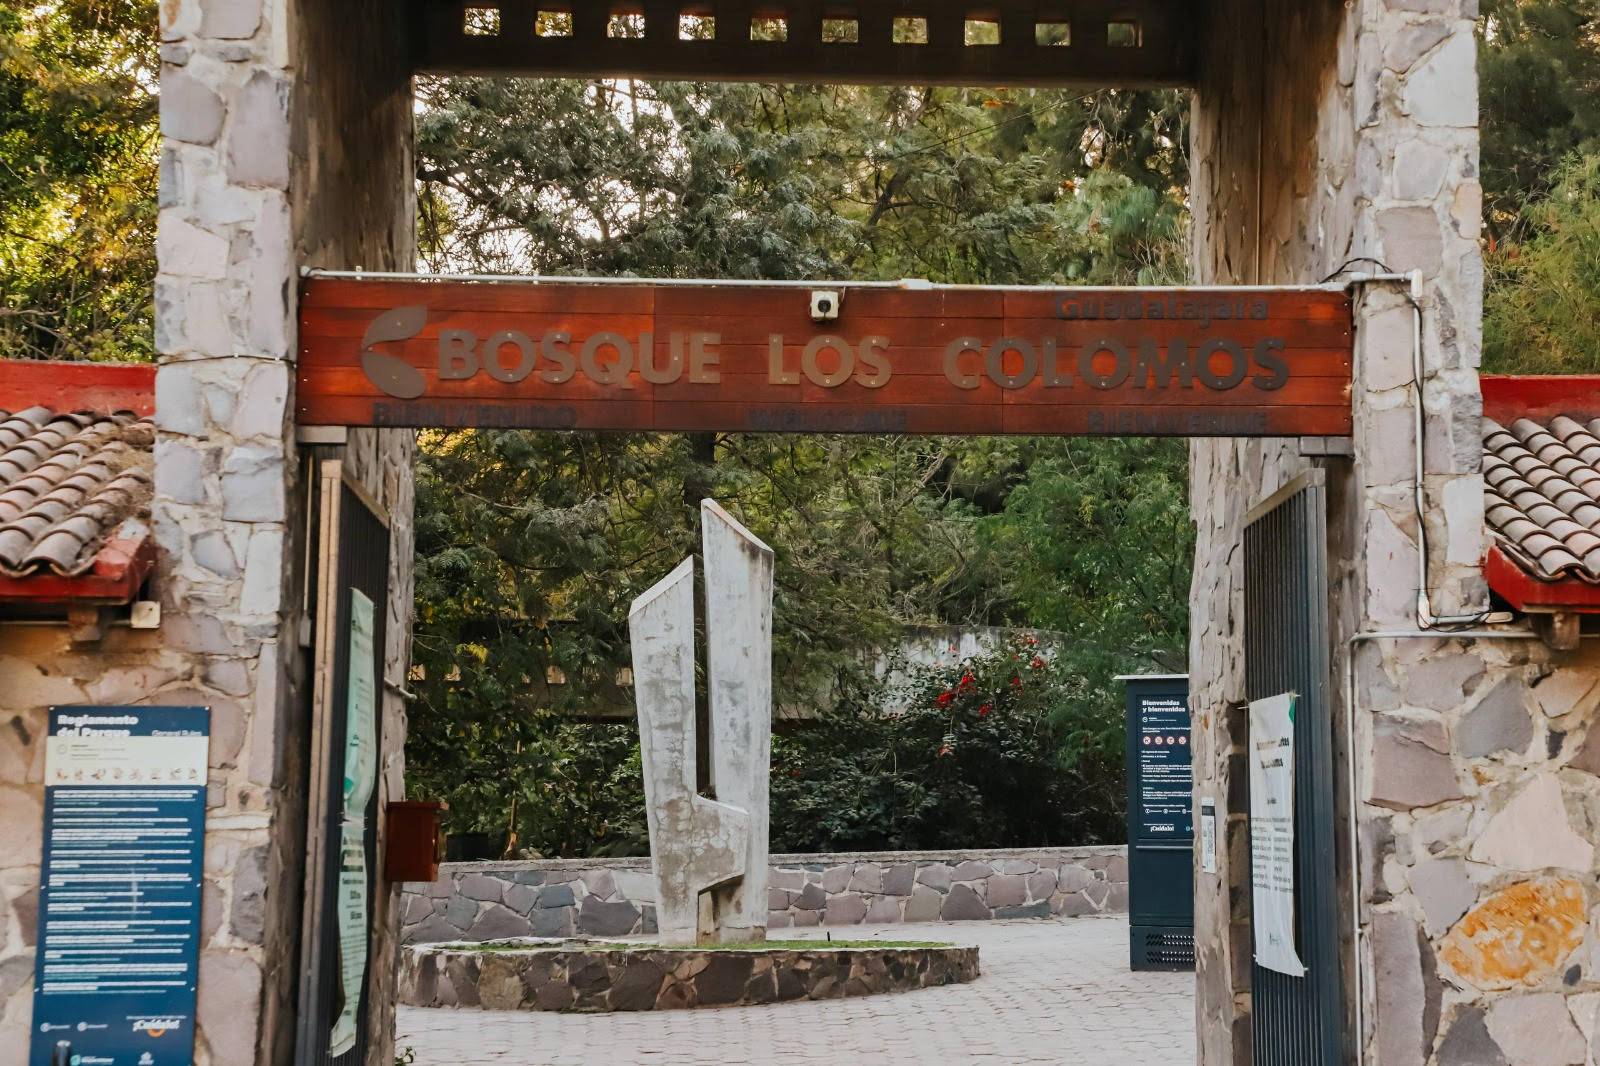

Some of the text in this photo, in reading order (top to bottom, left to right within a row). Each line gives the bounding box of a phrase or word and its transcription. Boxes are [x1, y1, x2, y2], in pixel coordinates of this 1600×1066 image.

[1055, 291, 1268, 329] Guadalajara
[437, 328, 1291, 391] BOSQUE LOS COLOMOS
[57, 714, 140, 727] Reglamento
